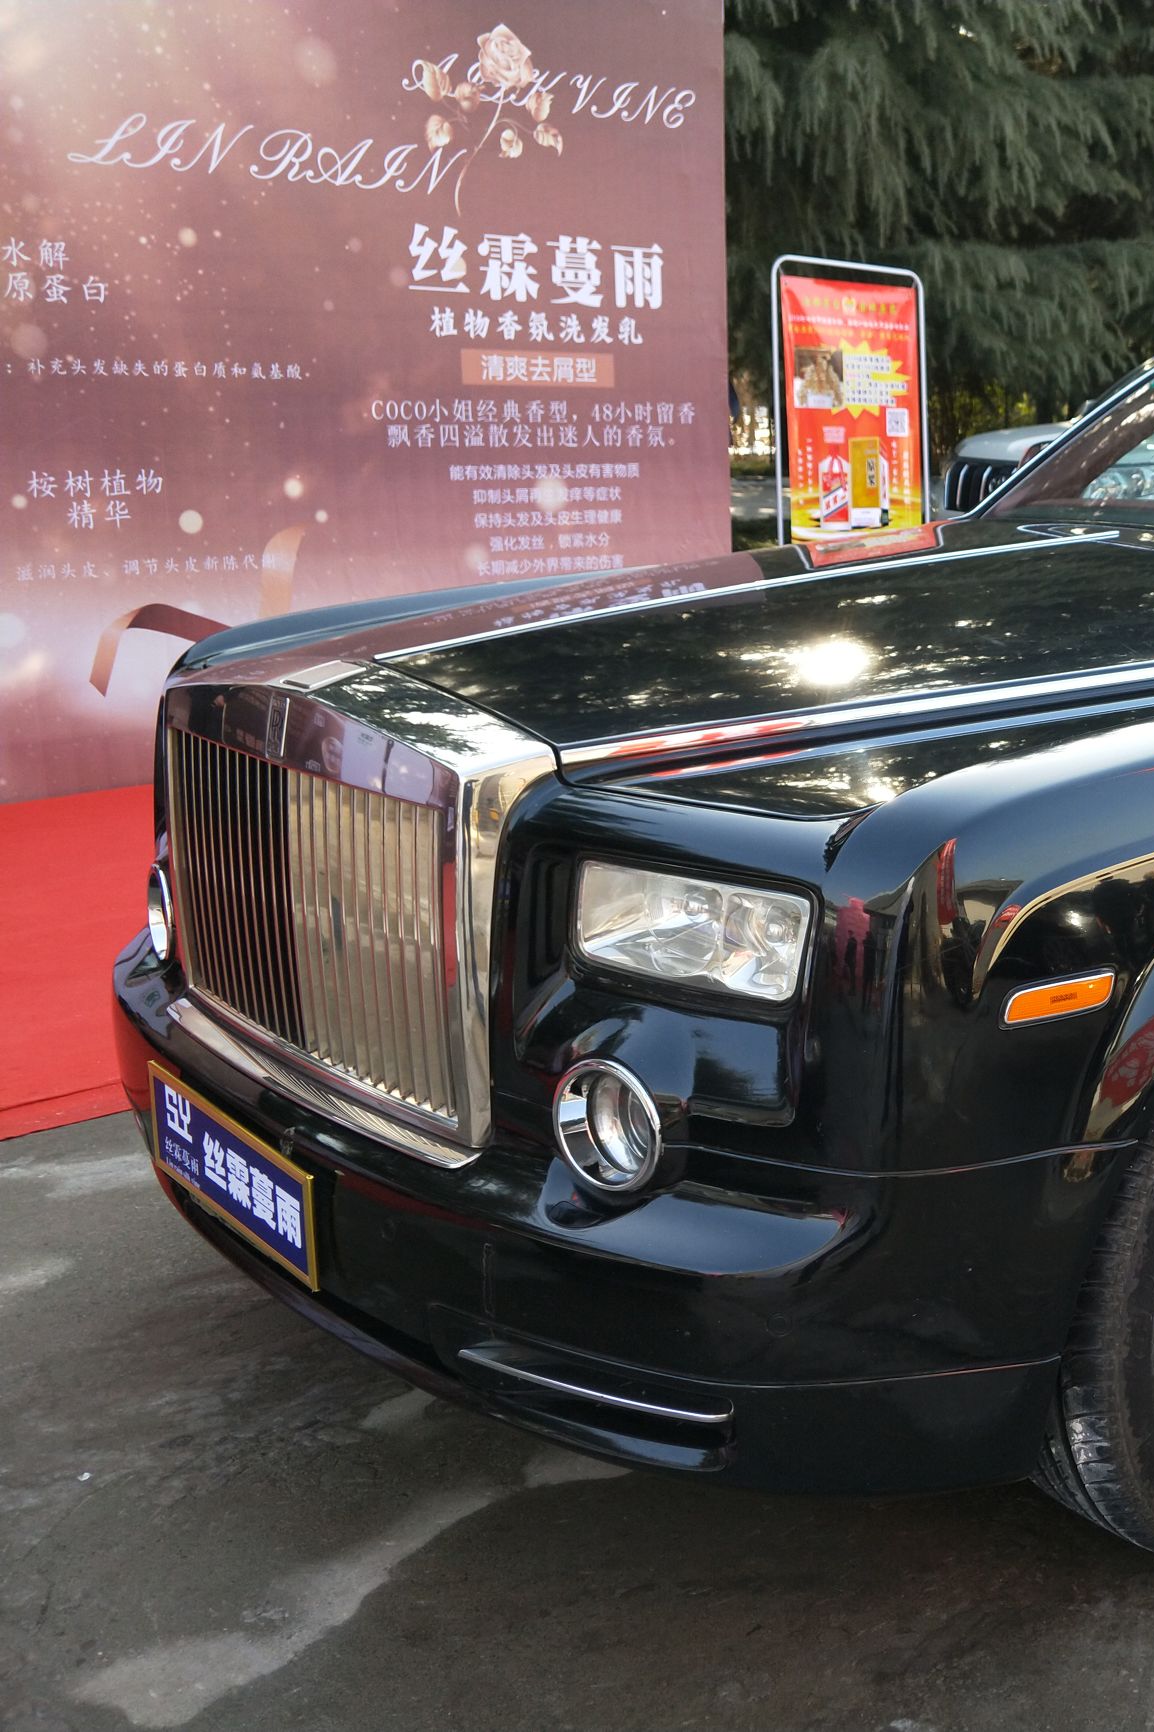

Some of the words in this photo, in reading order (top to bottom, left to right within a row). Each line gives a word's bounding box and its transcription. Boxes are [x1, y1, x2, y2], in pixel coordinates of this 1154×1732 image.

[67, 113, 255, 174] LIN
[249, 129, 467, 196] RAIN
[2, 237, 70, 270] 水解
[408, 223, 664, 309] 丝霖蔓雨
[4, 272, 109, 304] 原蛋白
[429, 306, 644, 346] 植物香氛洗发乳
[480, 354, 598, 384] 清爽去屑型
[27, 469, 164, 499] 桉树植物
[449, 462, 640, 481] 能有效清除头发及头皮有害物质
[67, 501, 131, 529] 精华
[474, 509, 623, 529] 保持头发及头皮生理健康
[203, 1131, 302, 1249] 丝霖蔓雨
